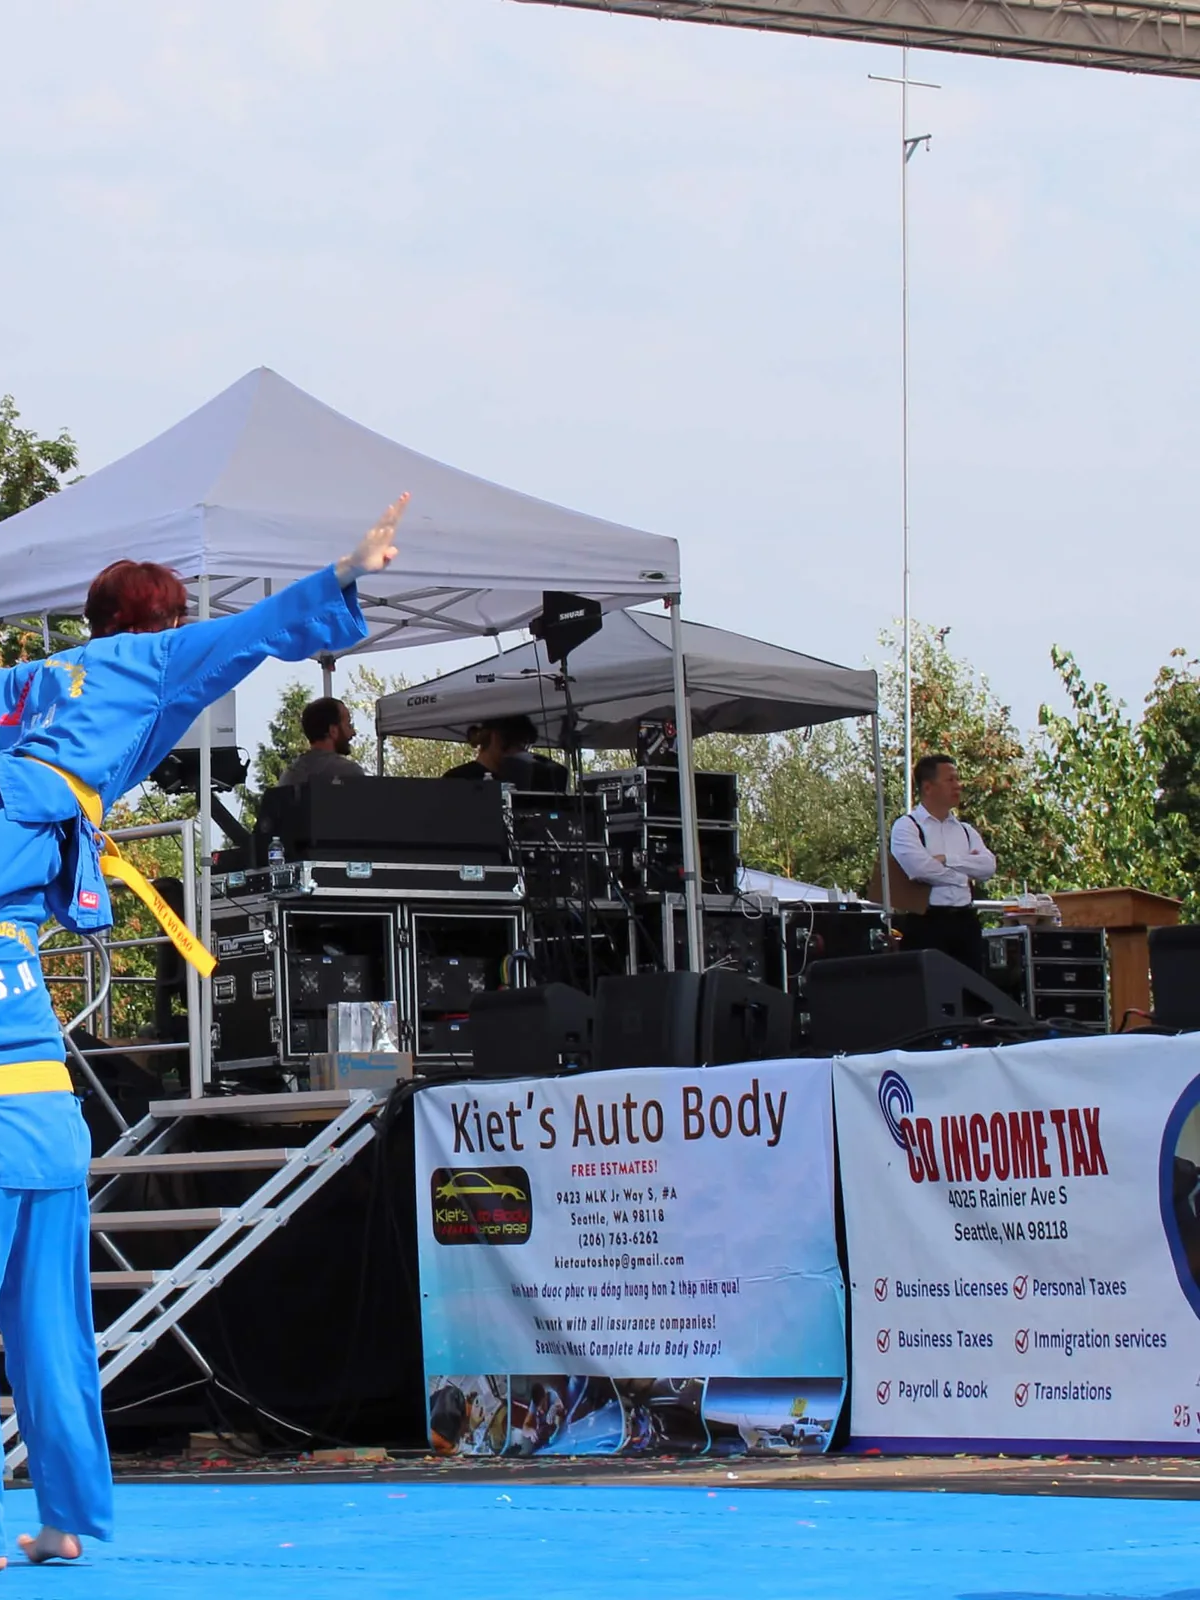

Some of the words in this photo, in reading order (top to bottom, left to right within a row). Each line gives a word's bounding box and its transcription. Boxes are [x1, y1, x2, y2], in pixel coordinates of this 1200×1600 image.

[559, 609, 585, 621] SHURE
[407, 695, 437, 707] CORE
[451, 1091, 557, 1153] Kiet's
[572, 1093, 665, 1148] Auto
[682, 1078, 788, 1148] Body
[941, 1110, 1051, 1182] INCOME
[1050, 1107, 1109, 1177] TAX
[571, 1163, 596, 1177] FREE
[600, 1160, 658, 1176] ESTMATES!
[556, 1191, 581, 1204] 9423
[585, 1190, 607, 1203] MLK
[611, 1190, 620, 1202] Jr
[623, 1188, 643, 1204] Way
[648, 1187, 657, 1202] S,
[662, 1186, 677, 1200] #A
[949, 1189, 977, 1208] 4025
[980, 1187, 1027, 1208] Rainier
[1031, 1187, 1056, 1206] Ave
[1058, 1186, 1068, 1204] S
[571, 1212, 609, 1226] Seattle,
[613, 1210, 629, 1224] WA
[632, 1208, 665, 1223] 98118
[578, 1233, 606, 1249] (206)
[609, 1231, 659, 1245] 763-6262
[954, 1221, 1002, 1244] Seattle,
[1003, 1222, 1025, 1240] WA
[1028, 1220, 1069, 1240] 98118
[554, 1253, 685, 1270] kietautoshop@gmail.com
[670, 1281, 675, 1295] 2
[895, 1279, 950, 1298] Business
[954, 1278, 1009, 1297] Licenses
[1032, 1277, 1086, 1297] Personal
[1089, 1278, 1127, 1296] Taxes
[566, 1316, 587, 1331] with
[591, 1316, 604, 1331] all
[607, 1316, 655, 1331] insurance
[660, 1314, 715, 1333] companies!
[898, 1329, 952, 1348] Business
[957, 1330, 993, 1347] Taxes
[1034, 1329, 1110, 1357] Immigration
[1115, 1330, 1167, 1348] services
[590, 1341, 634, 1360] Complete
[638, 1341, 660, 1356] Auto
[665, 1340, 689, 1359] Body
[693, 1339, 722, 1358] Shop!
[899, 1379, 939, 1402] Payroll
[943, 1381, 952, 1398] &
[957, 1380, 988, 1398] Book
[1034, 1381, 1112, 1400] Translations
[1174, 1404, 1191, 1428] 25
